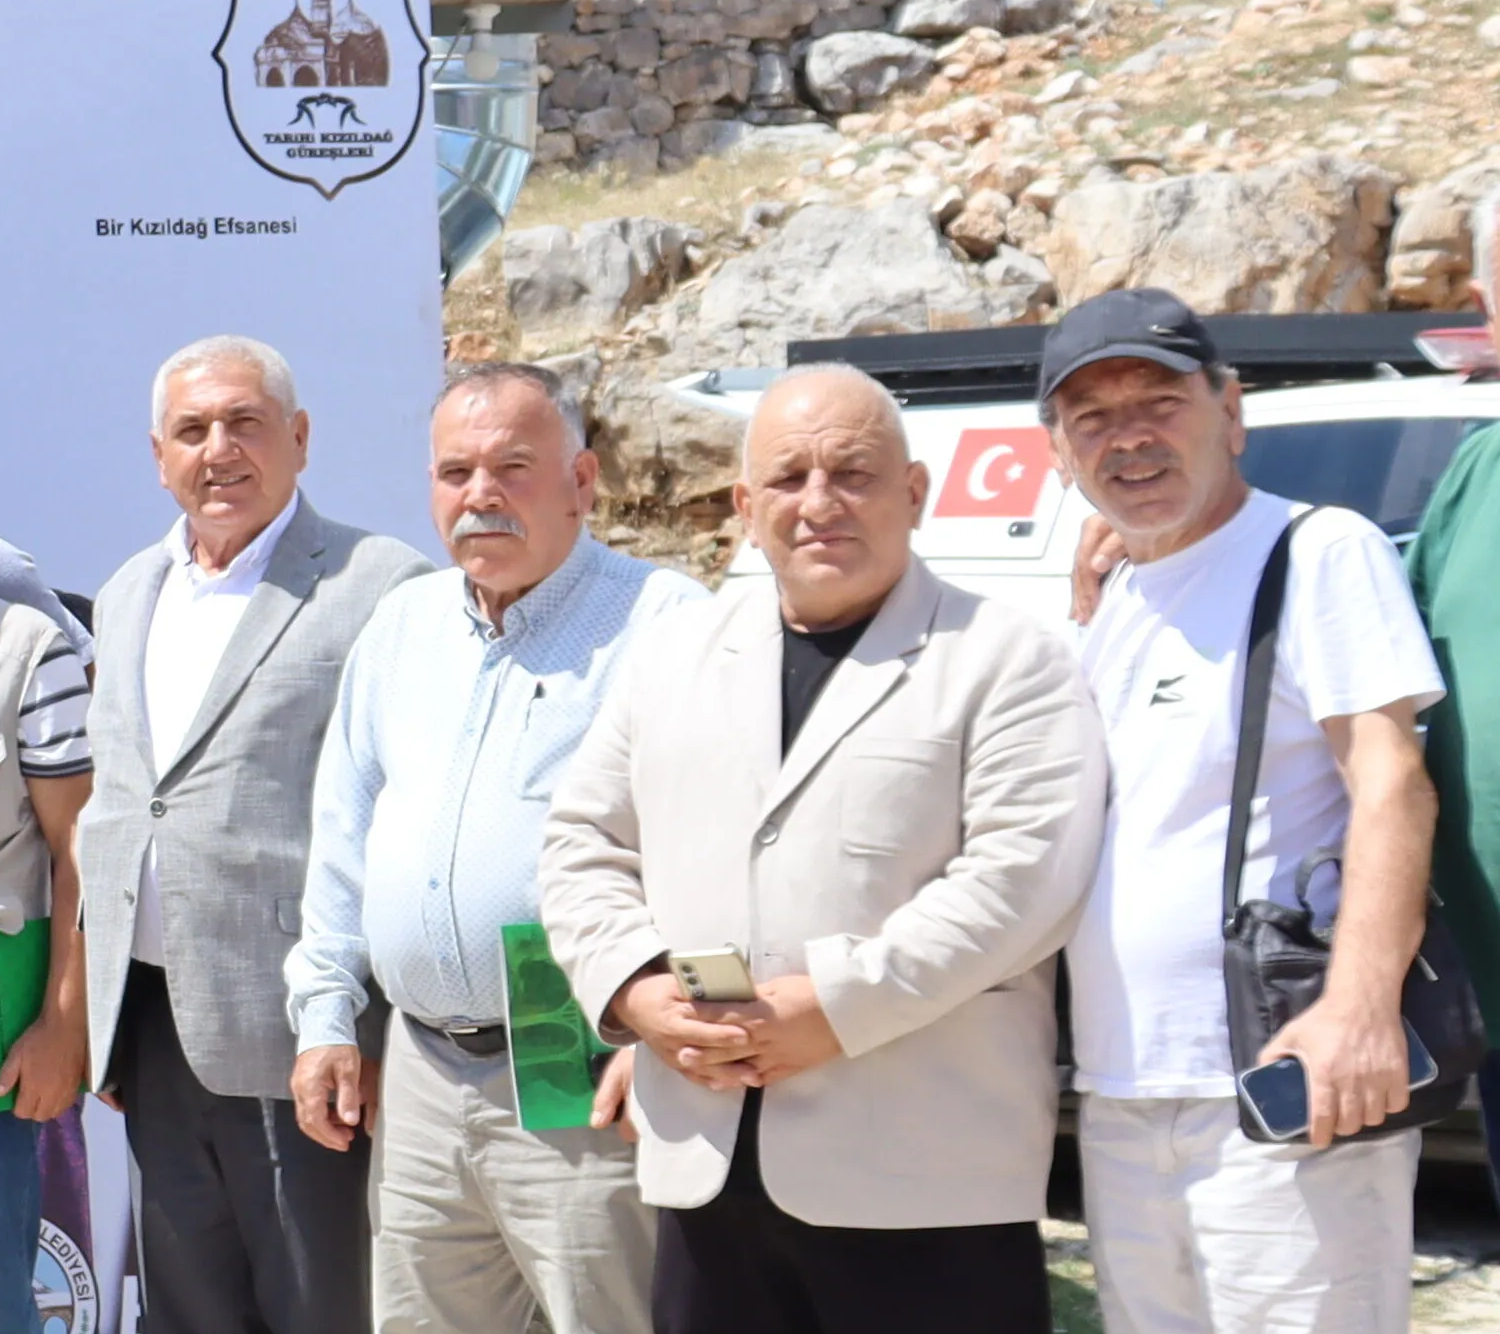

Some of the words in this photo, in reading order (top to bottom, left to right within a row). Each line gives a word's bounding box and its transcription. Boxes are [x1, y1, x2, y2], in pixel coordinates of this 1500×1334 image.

[96, 219, 124, 236] Bir
[131, 218, 208, 239] Kızıldağ
[214, 217, 297, 235] Efsanesi
[40, 1225, 94, 1301] LEDİYESİ
